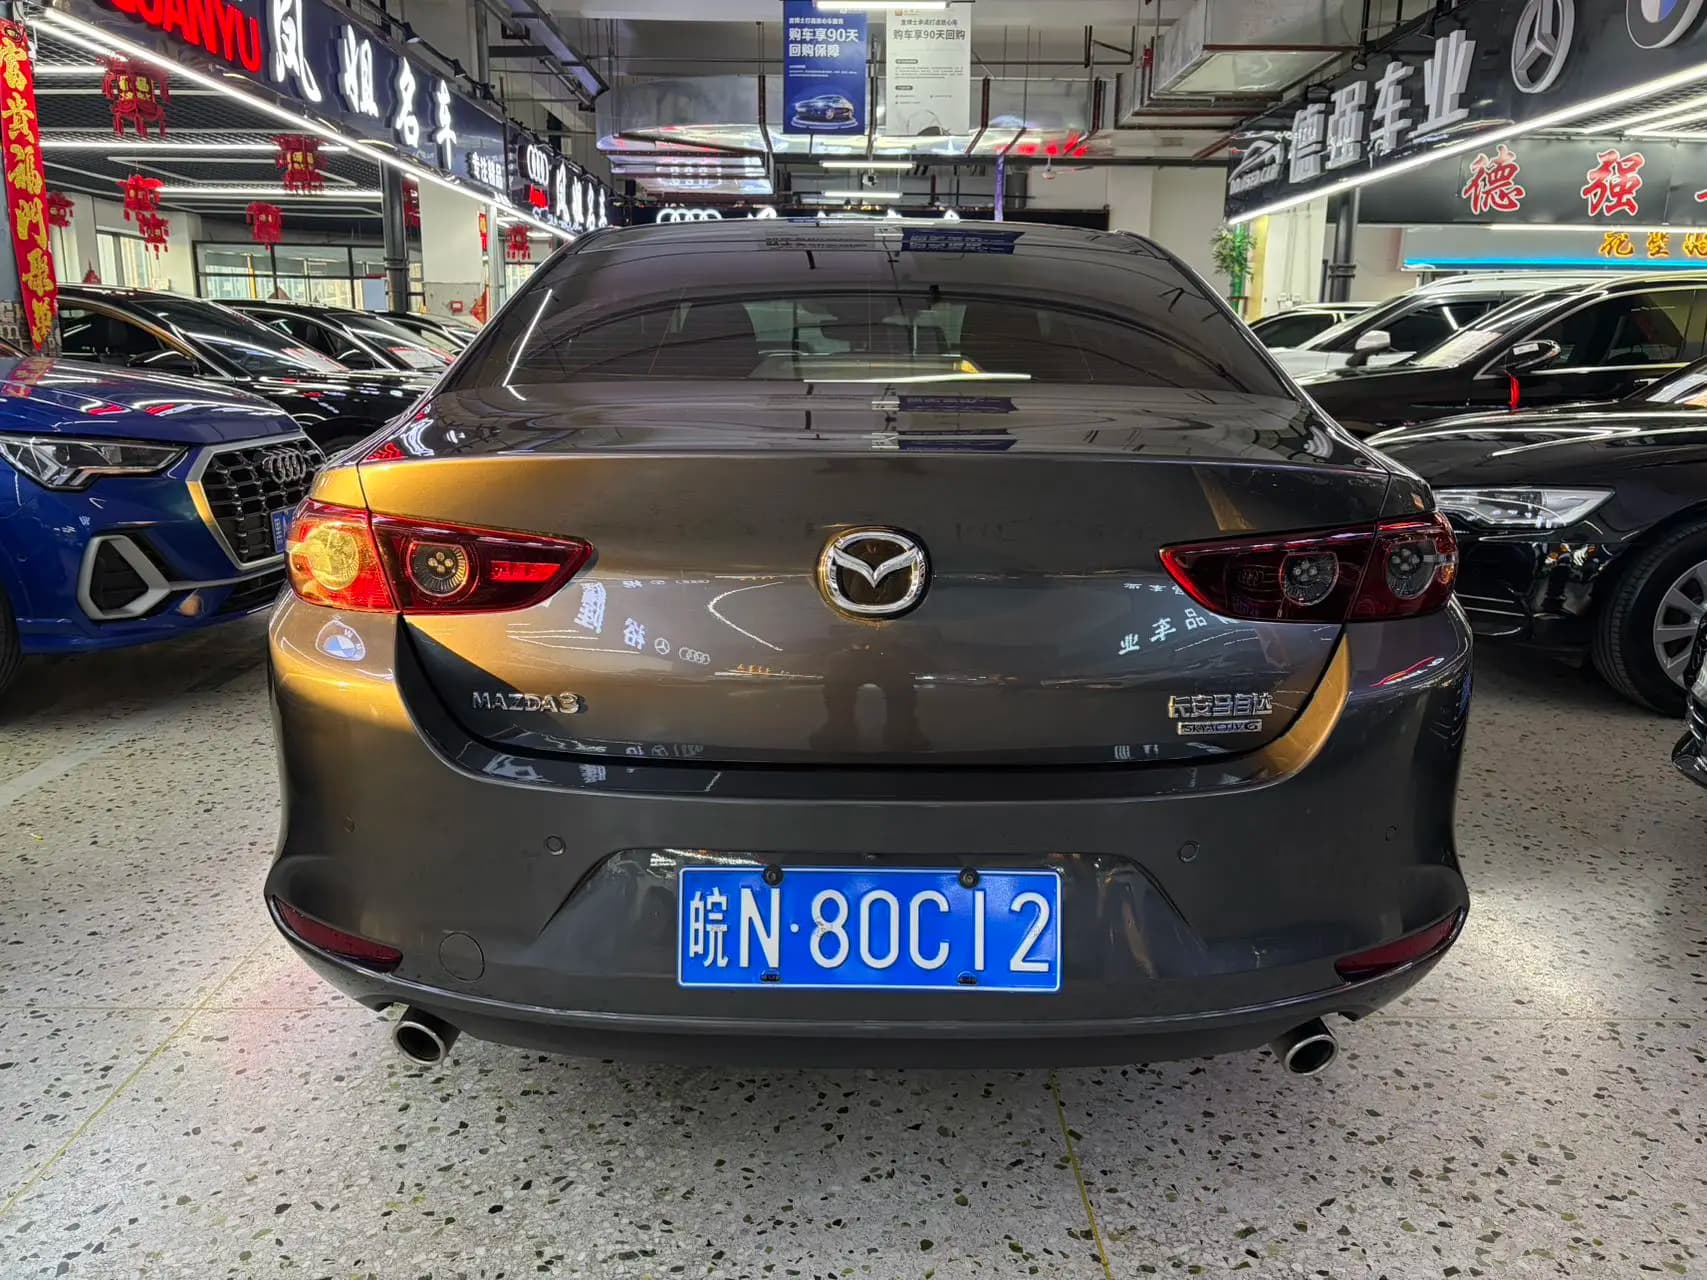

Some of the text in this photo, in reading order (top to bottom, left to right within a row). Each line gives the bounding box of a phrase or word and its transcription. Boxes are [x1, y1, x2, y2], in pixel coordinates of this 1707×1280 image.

[789, 28, 859, 42] 购车享90天
[893, 29, 966, 41] 购车享90天回购
[789, 44, 840, 57] 回购保障
[1461, 144, 1707, 217] 德强
[472, 691, 580, 714] MAZDA3
[1168, 692, 1273, 718] 长安马自达
